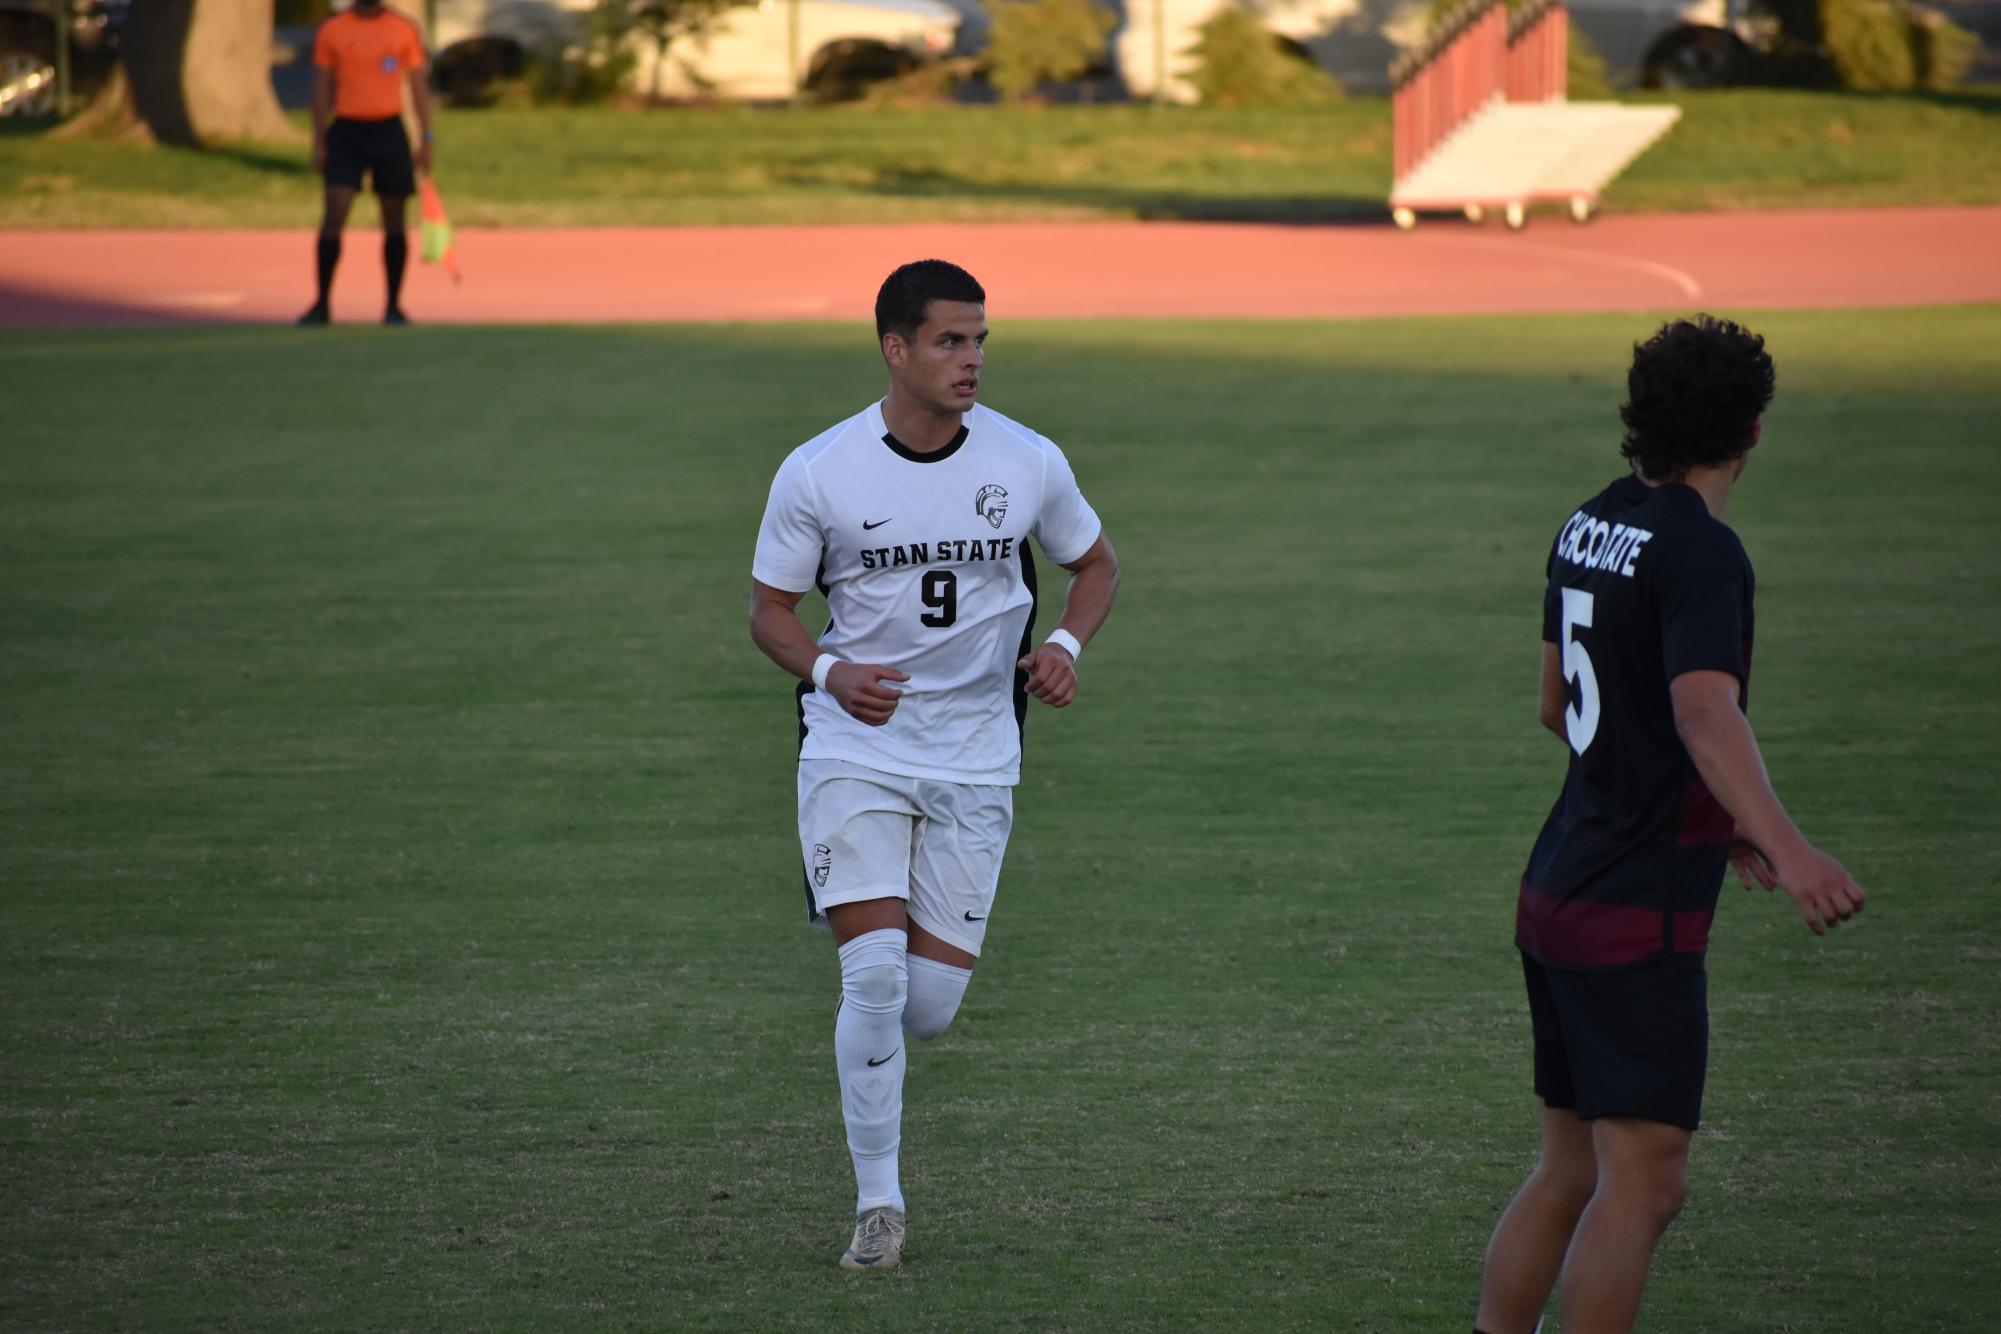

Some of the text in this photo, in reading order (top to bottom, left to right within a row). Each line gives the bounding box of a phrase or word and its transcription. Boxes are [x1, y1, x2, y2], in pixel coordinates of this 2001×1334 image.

[860, 537, 1014, 569] STAN STATE
[920, 570, 957, 628] 9
[1561, 586, 1600, 757] 5
